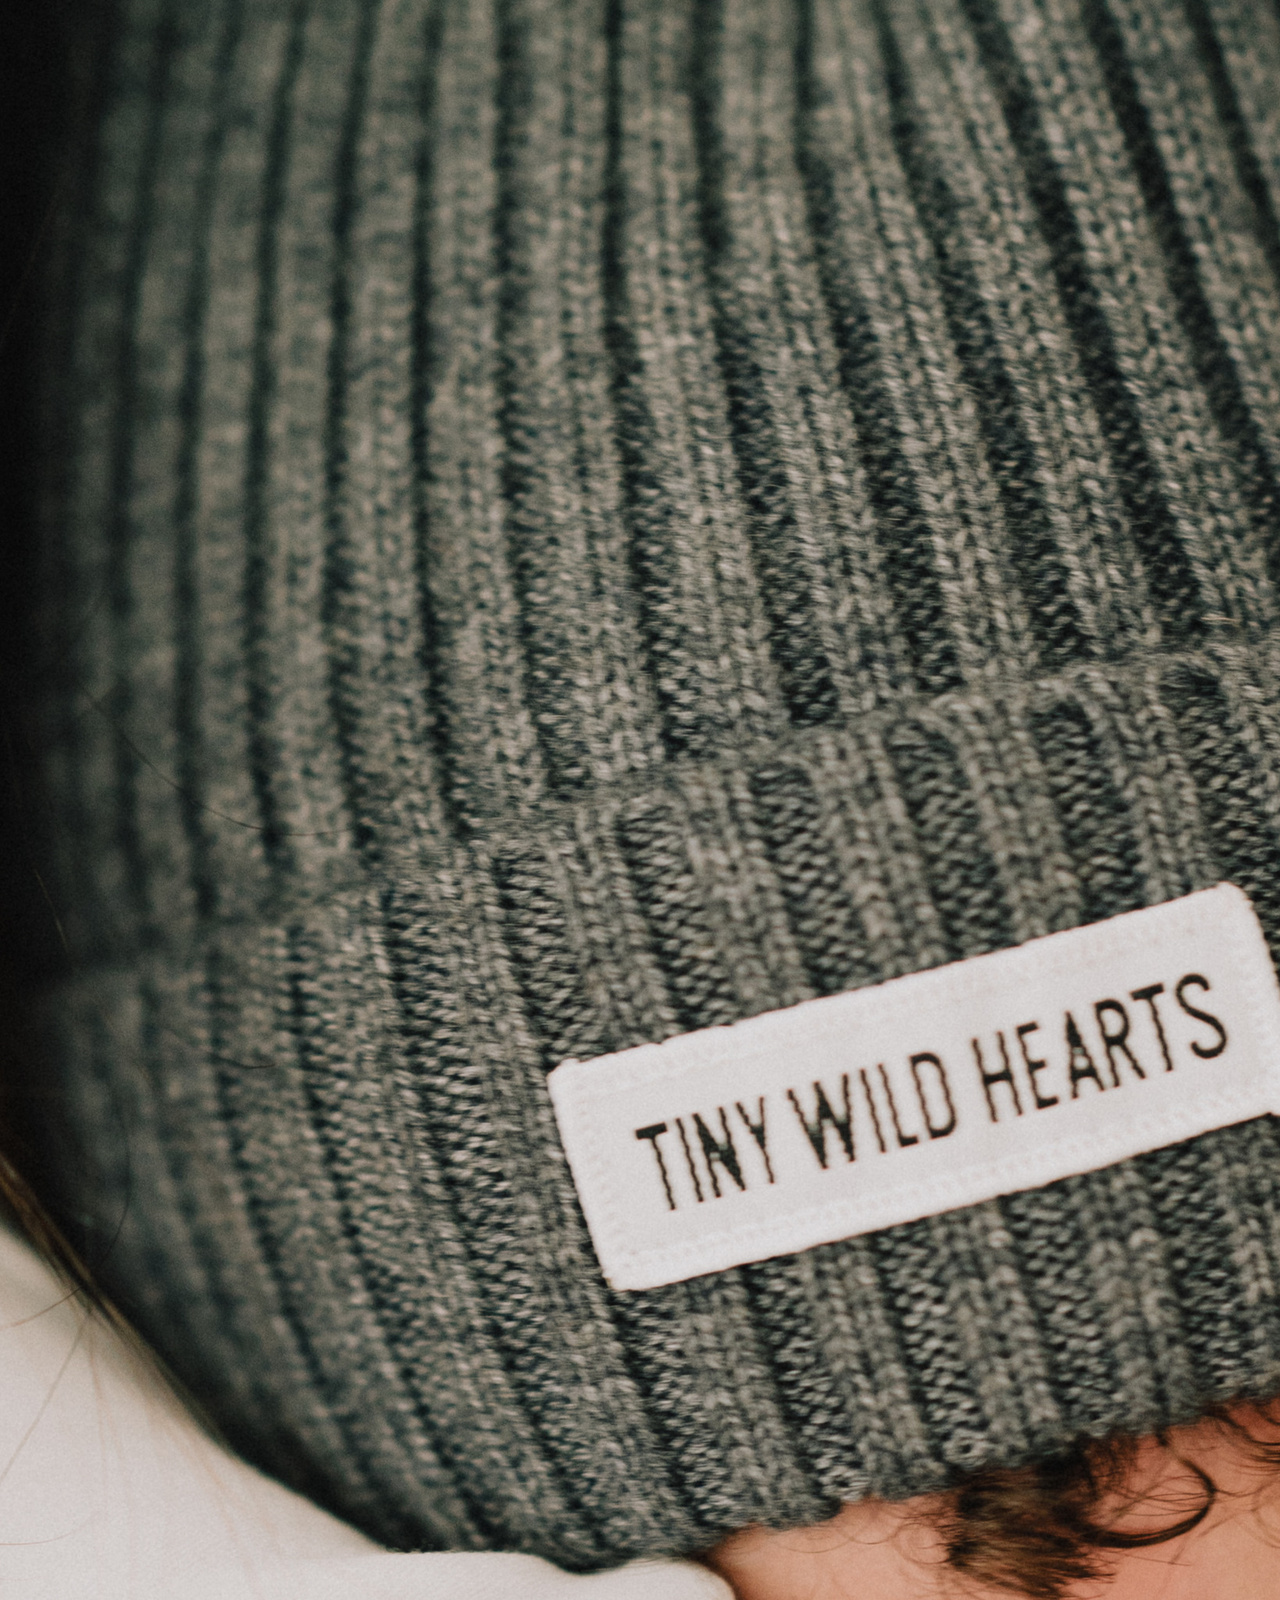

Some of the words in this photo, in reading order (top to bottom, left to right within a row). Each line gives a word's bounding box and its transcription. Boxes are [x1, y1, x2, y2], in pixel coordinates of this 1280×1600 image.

[633, 1096, 775, 1211] TINY
[787, 1052, 957, 1170] WILD
[971, 973, 1228, 1123] HEARTS
